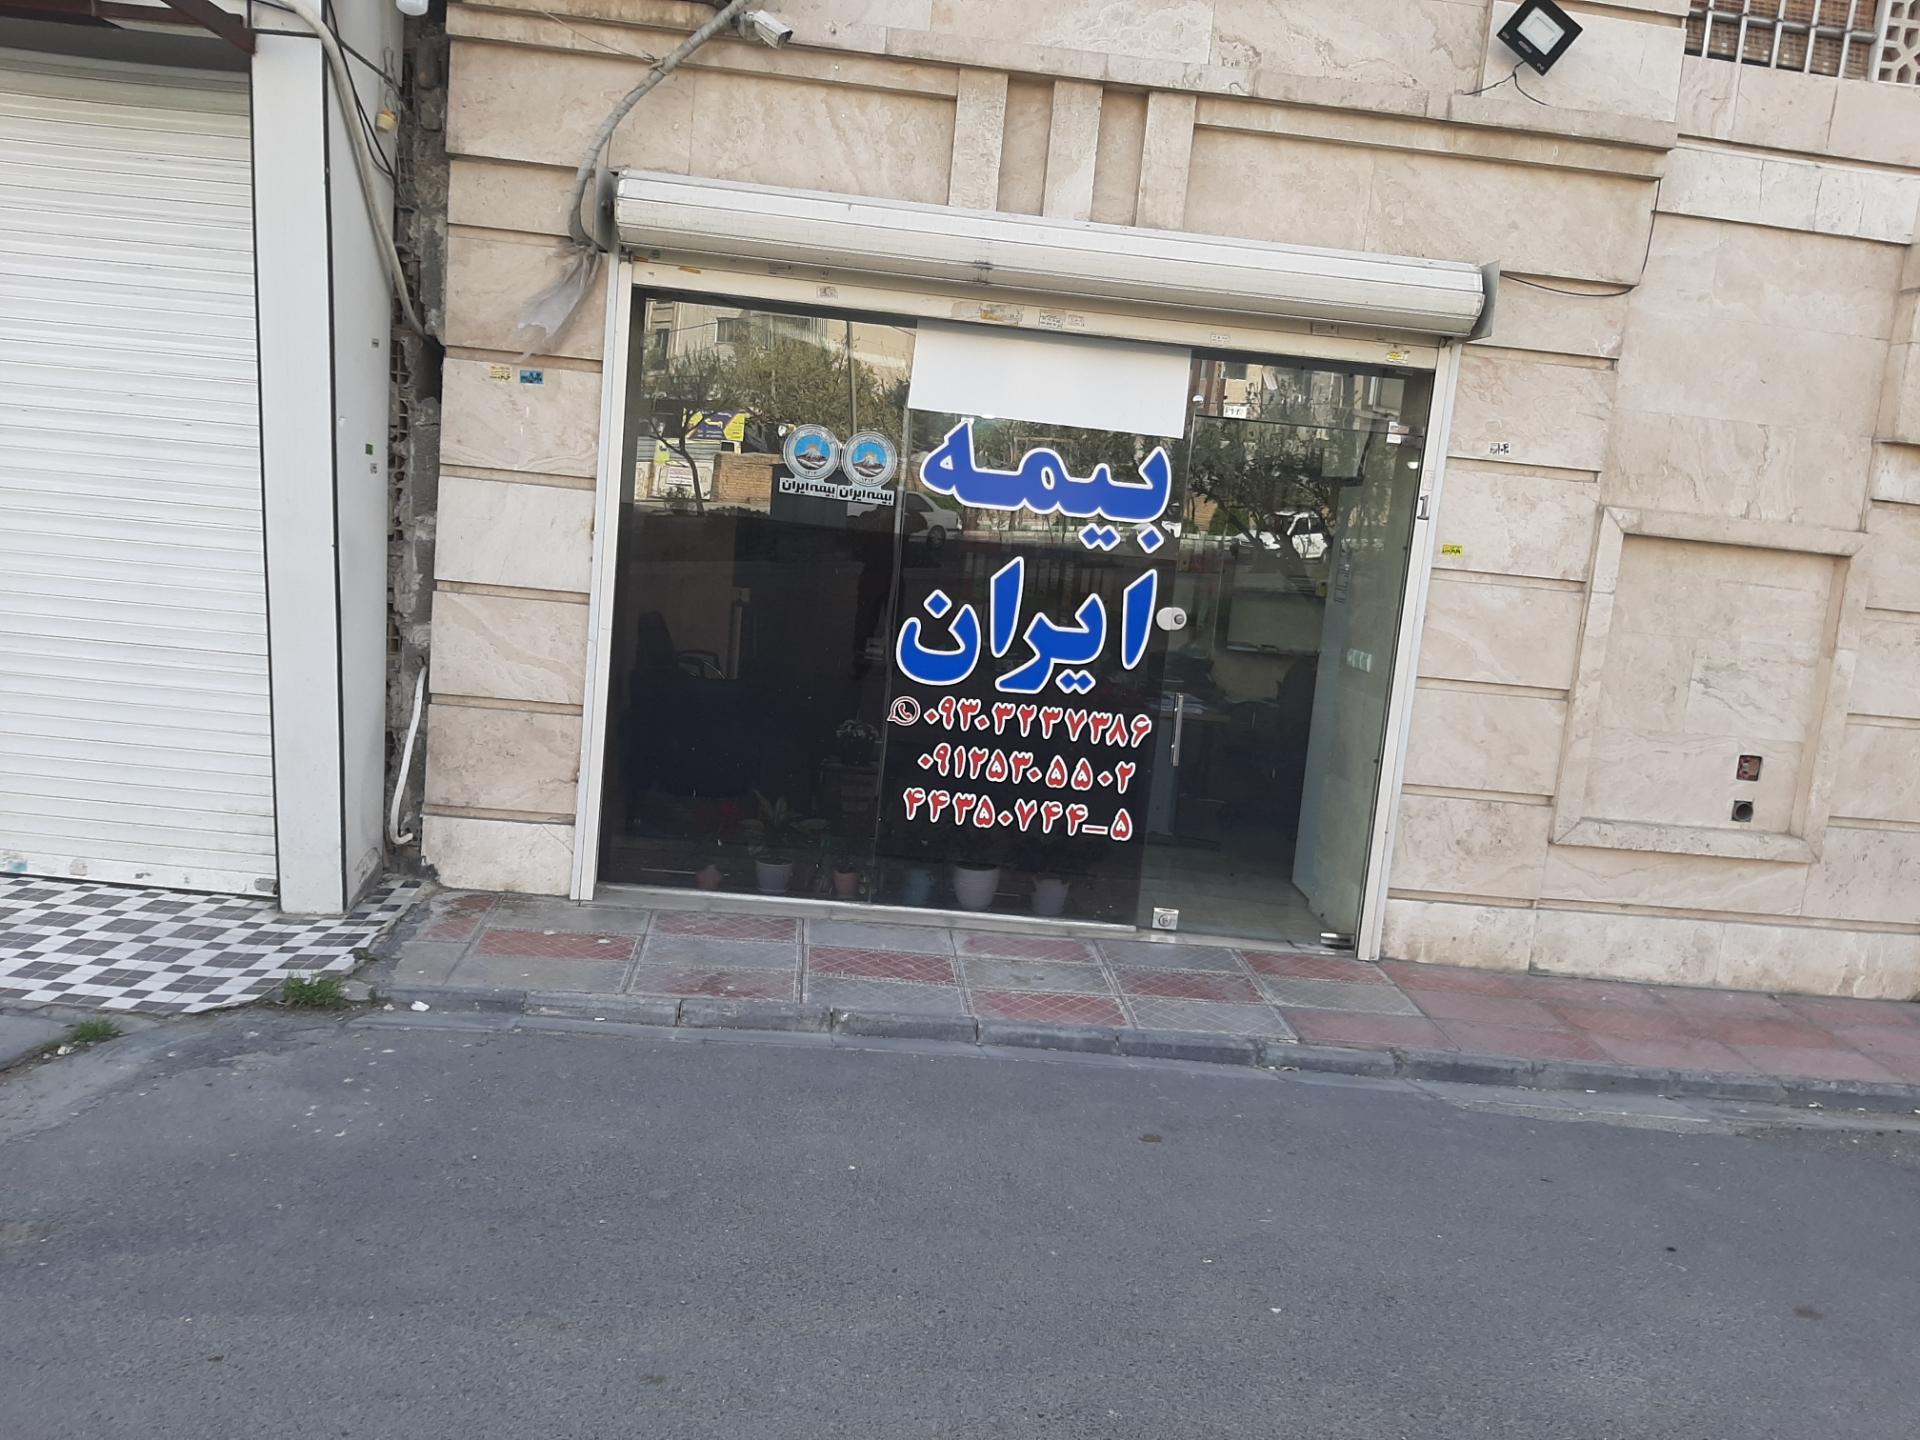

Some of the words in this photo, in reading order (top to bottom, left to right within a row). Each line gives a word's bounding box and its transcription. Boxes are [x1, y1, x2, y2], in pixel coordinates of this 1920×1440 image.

[782, 479, 809, 494] ایران
[809, 482, 836, 497] بیمه
[839, 487, 866, 502] ایران
[867, 490, 892, 505] بیمه
[920, 417, 1172, 553] بیمه
[896, 556, 1158, 694] ایران
[924, 696, 1152, 748] ۰۹۳۰۳۲۳۷۳۸۶
[918, 743, 1136, 794] ۰۹۱۲۵۳۰۵۵۰۲
